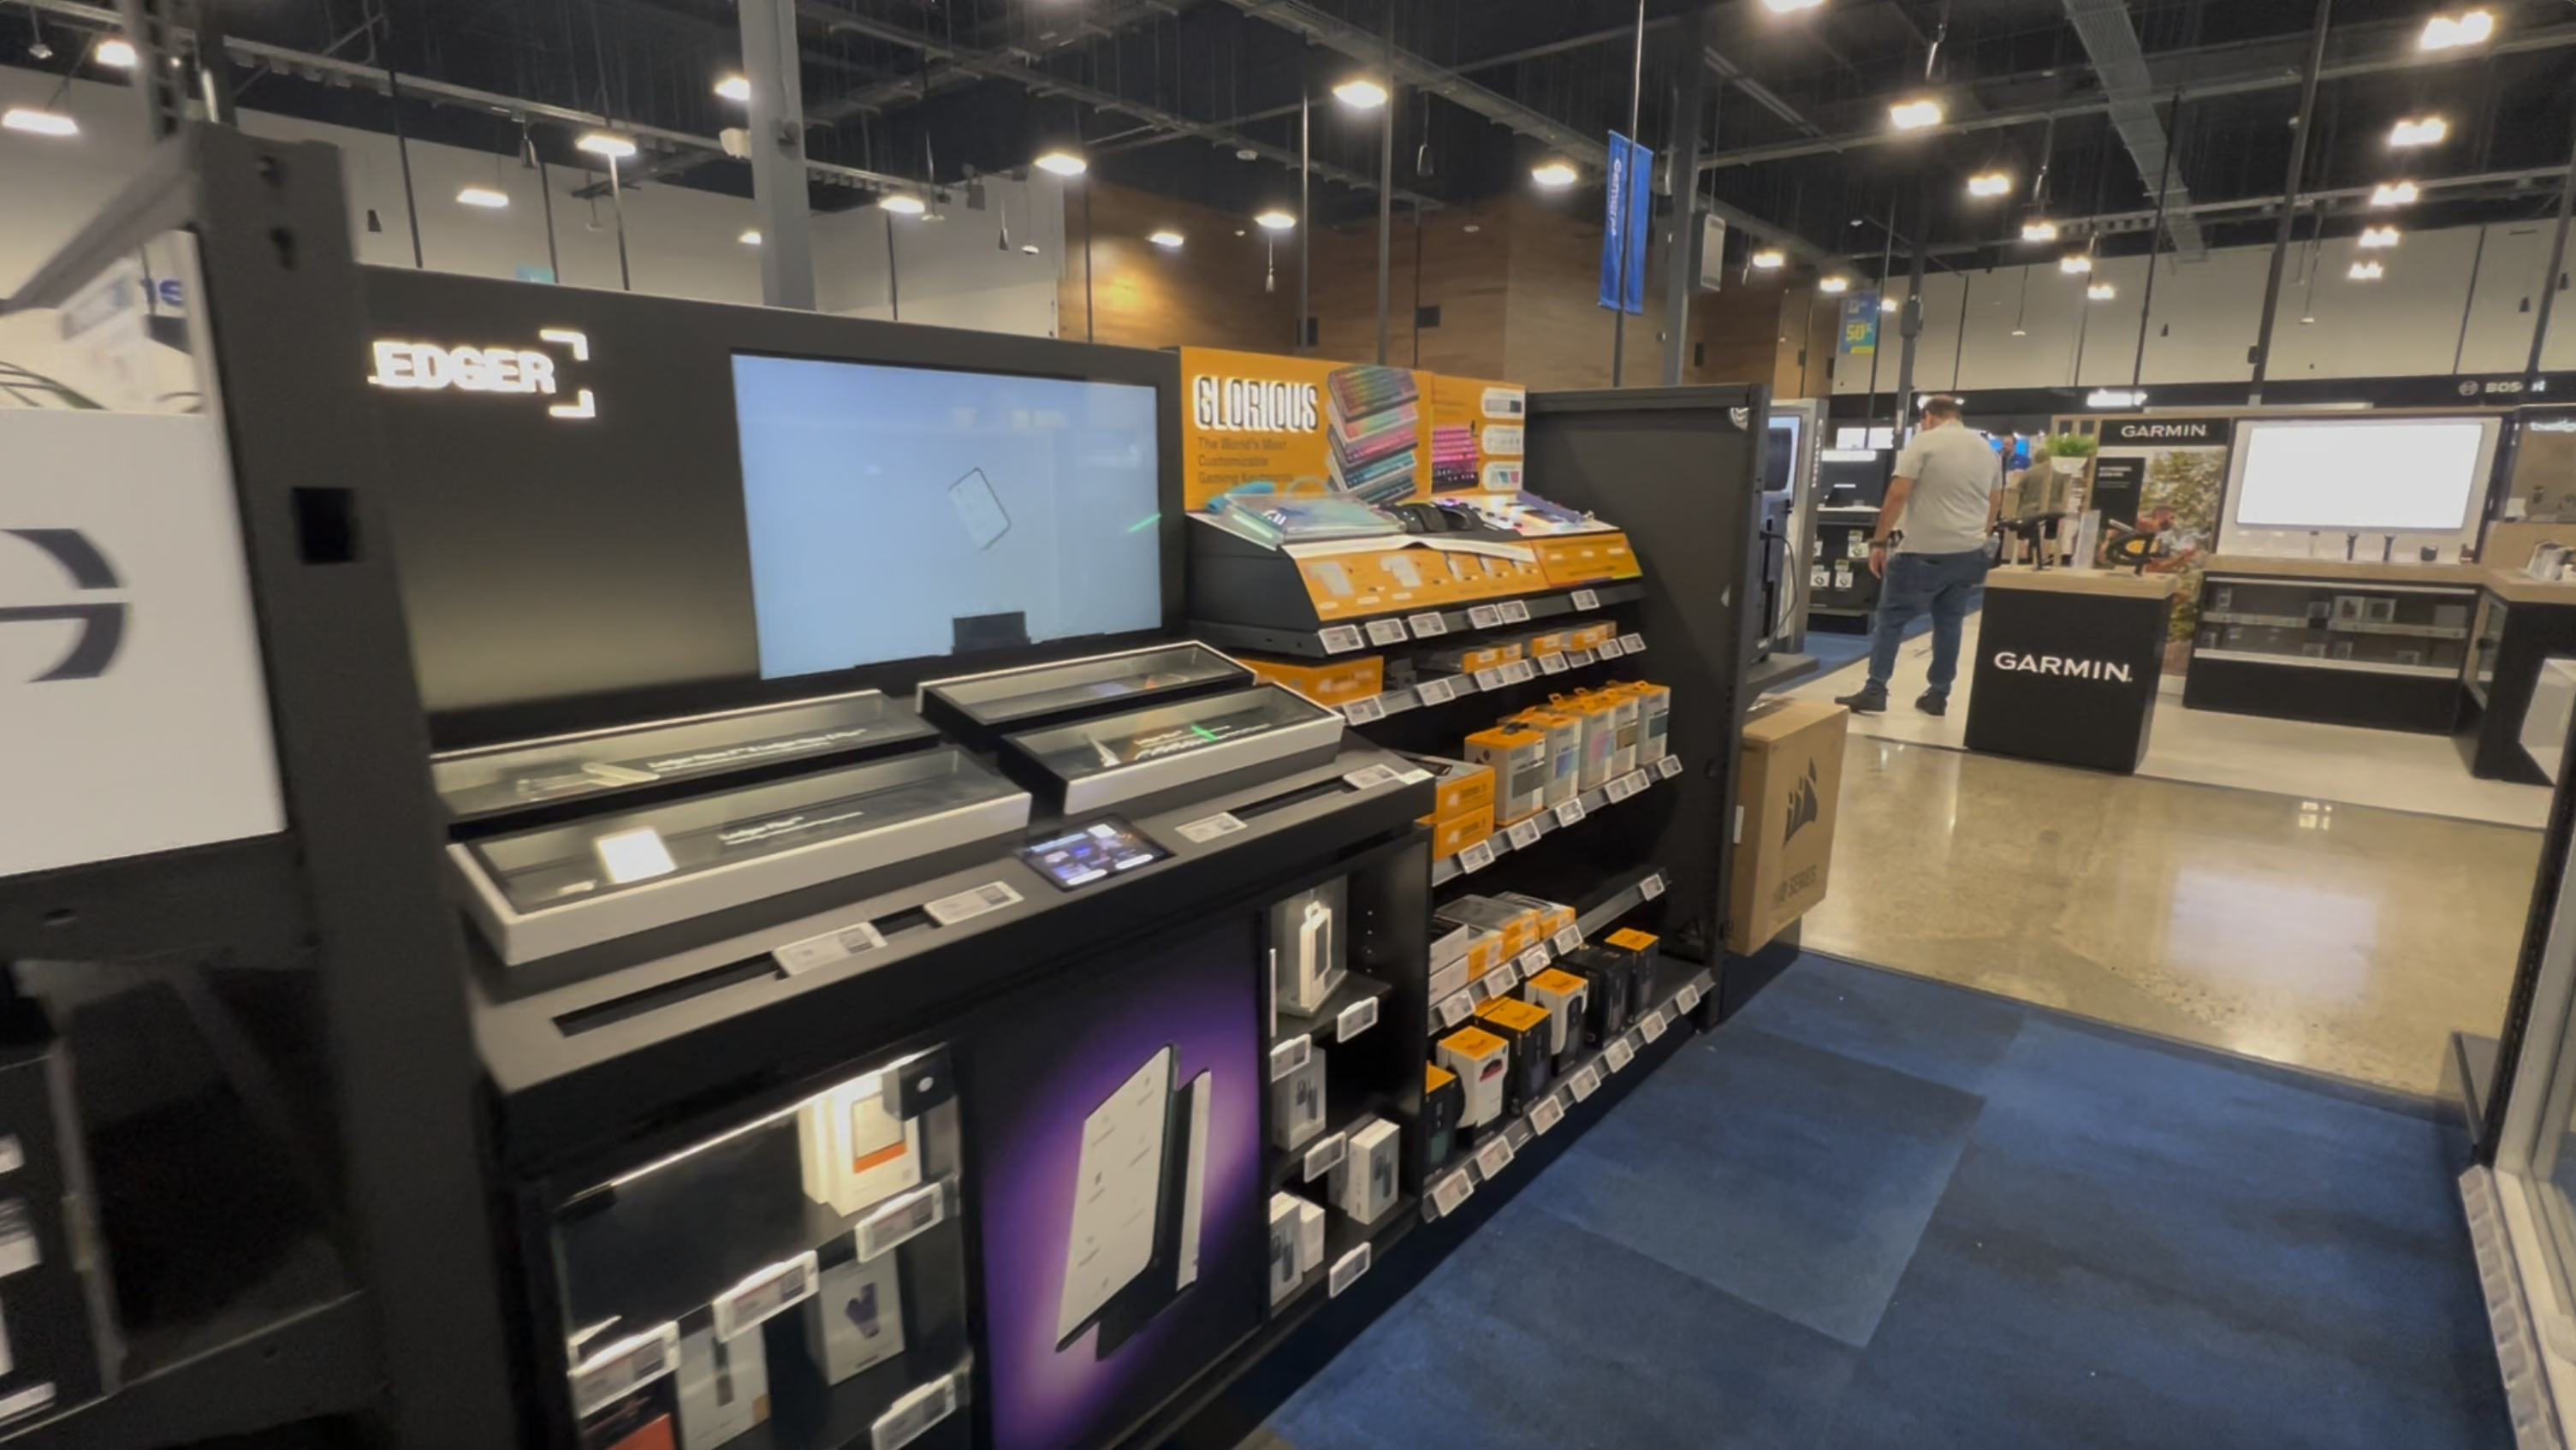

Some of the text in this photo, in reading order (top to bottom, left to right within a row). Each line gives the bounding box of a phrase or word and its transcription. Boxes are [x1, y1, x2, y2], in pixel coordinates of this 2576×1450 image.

[2485, 380, 2546, 394] BOSH
[1193, 374, 1319, 434] GLORIOUS
[2121, 424, 2206, 438] GARMIN
[1198, 437, 1218, 450] The
[1993, 651, 2130, 683] GARMIN
